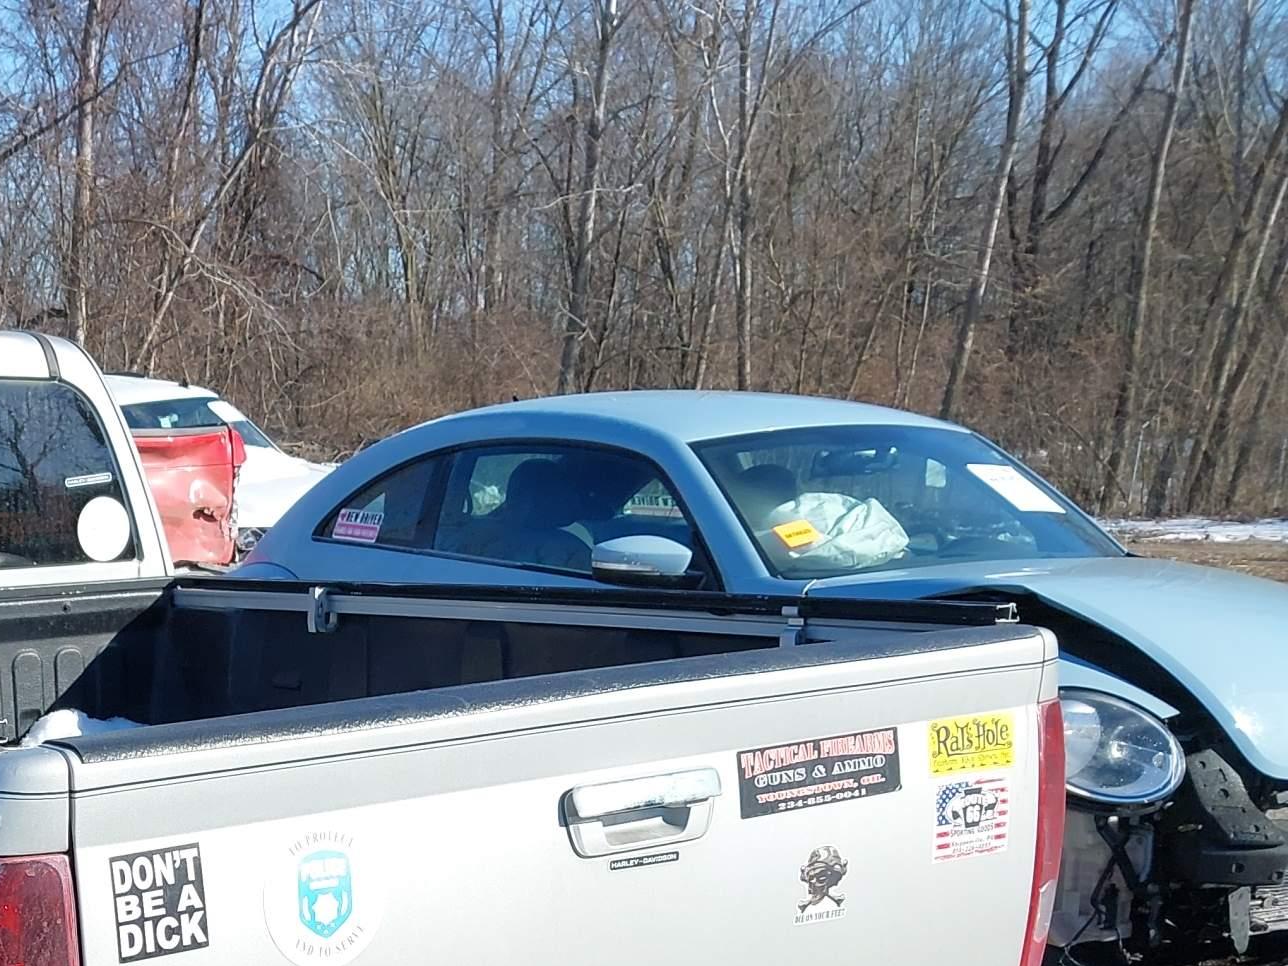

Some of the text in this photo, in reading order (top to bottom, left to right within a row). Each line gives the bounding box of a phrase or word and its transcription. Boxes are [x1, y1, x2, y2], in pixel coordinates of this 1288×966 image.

[740, 729, 896, 779] TACTICAL FIREARMS
[754, 754, 886, 788] GUNS & AMMO
[965, 804, 981, 823] 66
[111, 847, 199, 894] DON'T
[611, 853, 677, 869] HARLEY-DAVIDSON
[115, 883, 204, 924] BE A
[118, 910, 207, 958] DICK
